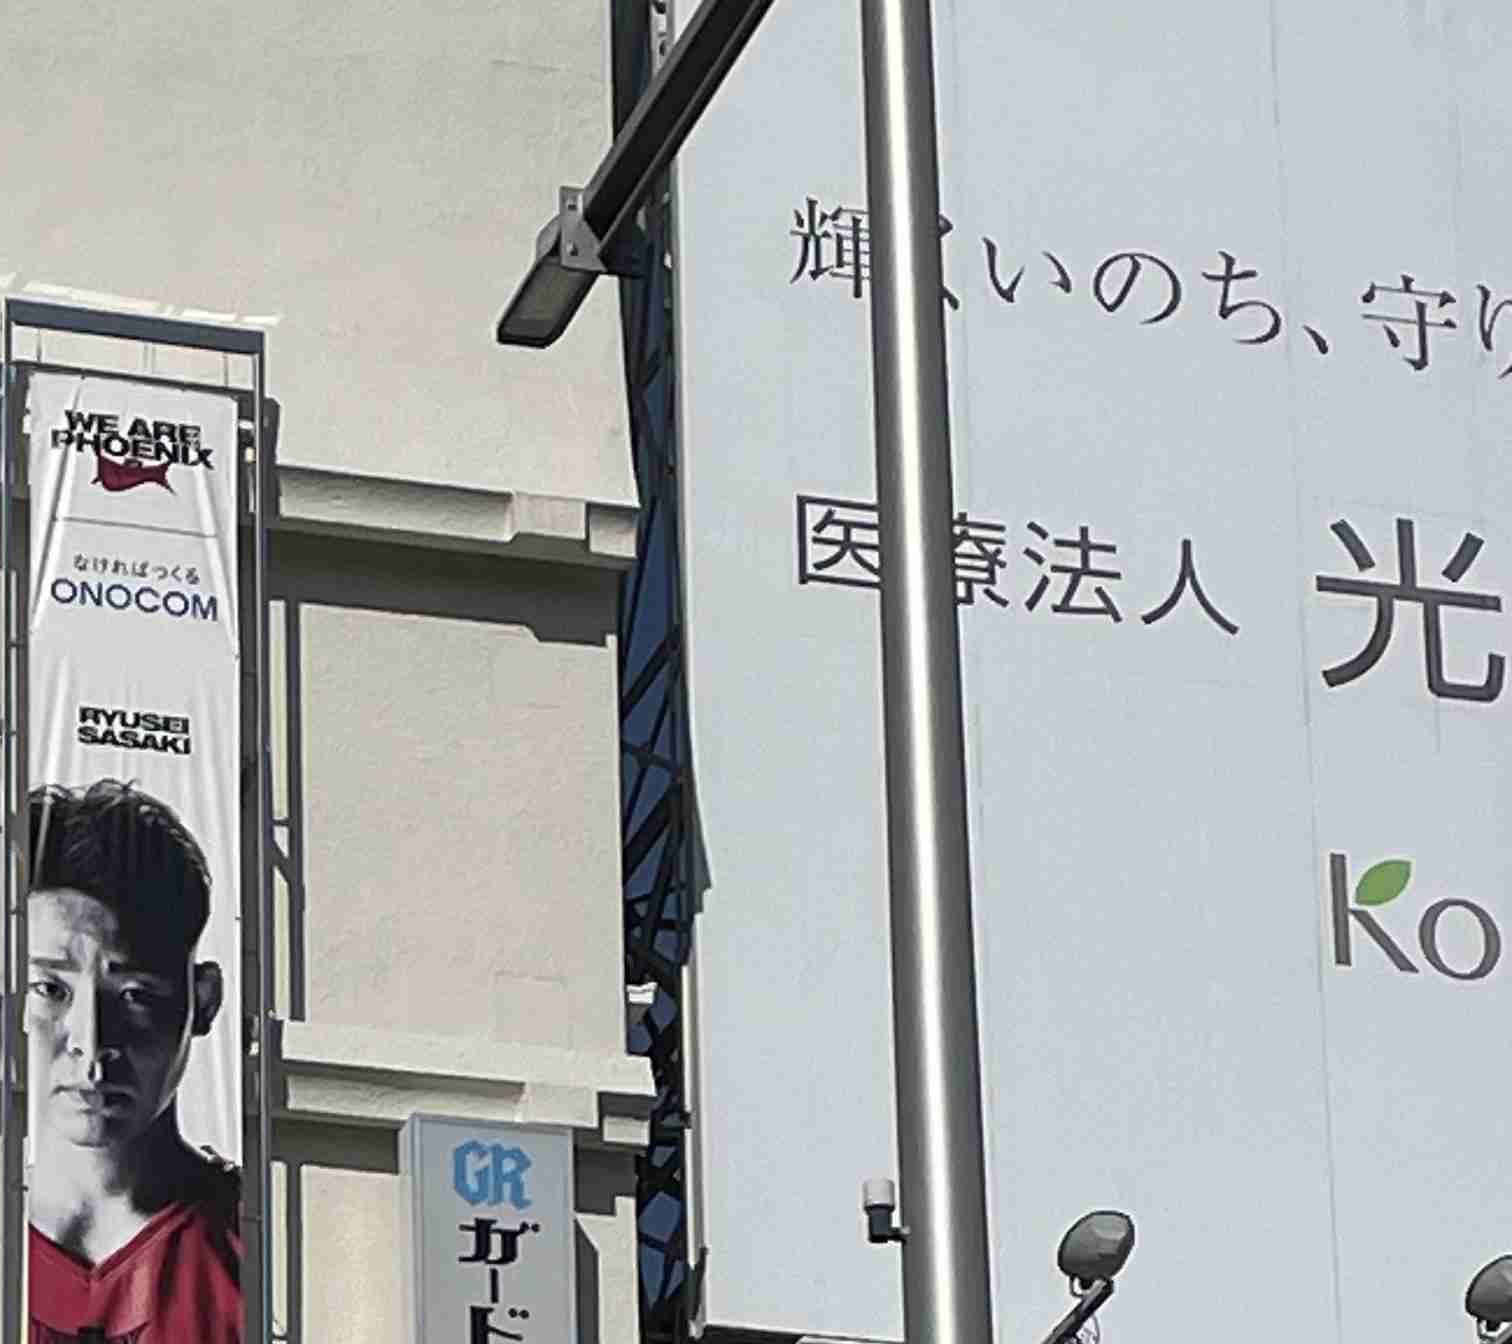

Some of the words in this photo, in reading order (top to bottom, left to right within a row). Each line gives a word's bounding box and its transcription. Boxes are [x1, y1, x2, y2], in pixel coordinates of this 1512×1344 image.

[64, 409, 119, 435] WE
[128, 416, 201, 447] ARE
[51, 429, 214, 470] PHOENIX
[73, 553, 201, 585] なければつくる
[50, 578, 218, 622] ONOCOM
[78, 706, 190, 735] RYUSEI
[77, 725, 192, 755] SASAKI
[452, 1138, 532, 1212] GR
